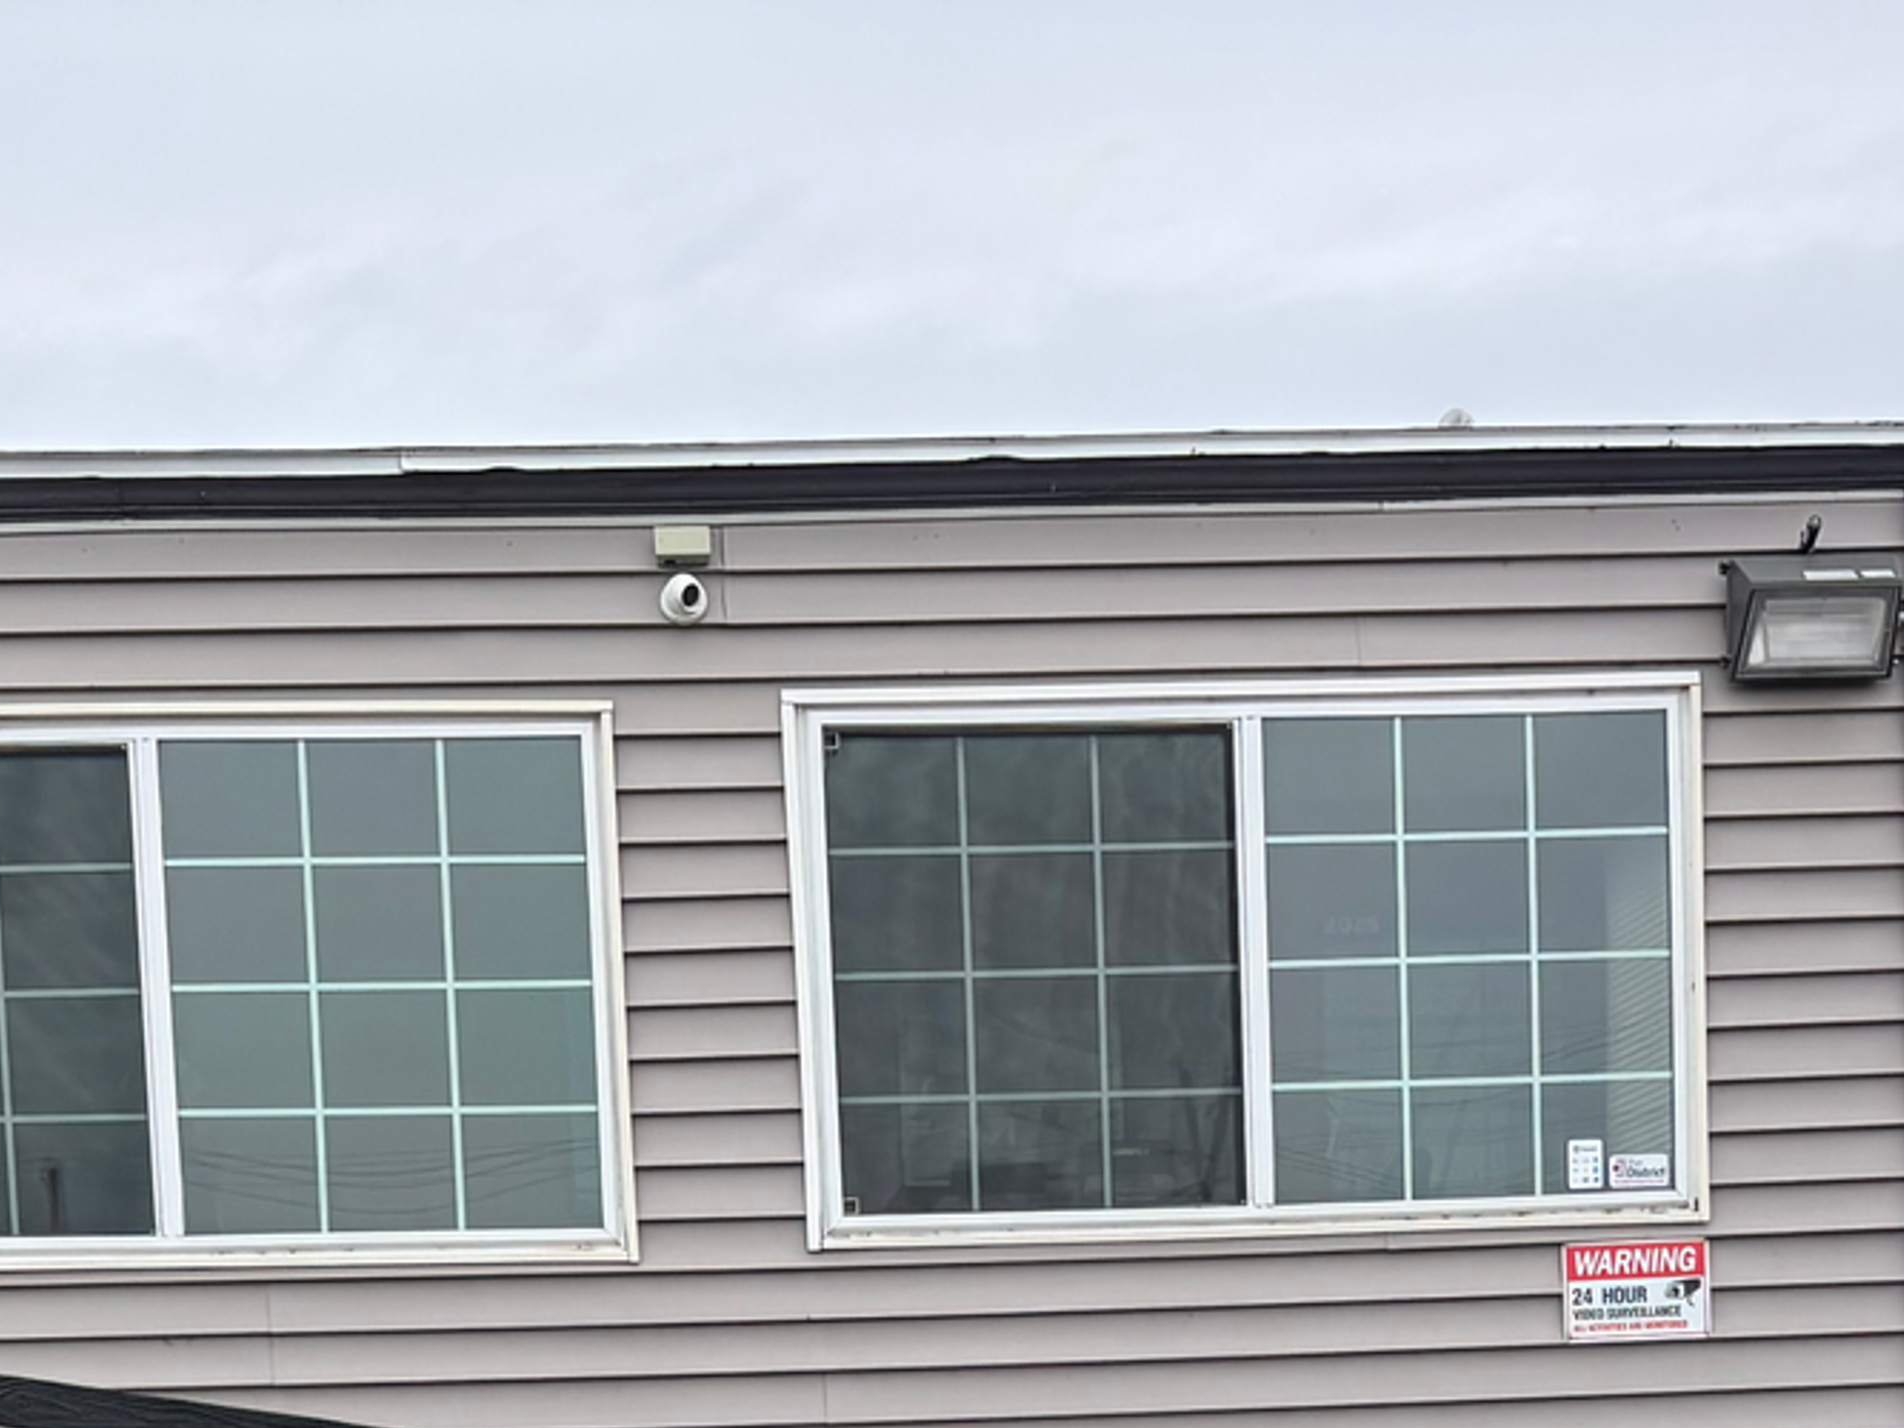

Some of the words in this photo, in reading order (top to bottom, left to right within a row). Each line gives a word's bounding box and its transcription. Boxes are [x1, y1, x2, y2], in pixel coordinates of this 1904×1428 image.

[1574, 1246, 1696, 1277] WARNING
[1572, 1287, 1593, 1305] 24
[1602, 1286, 1647, 1304] HOUR
[1573, 1307, 1604, 1320] VIDEO
[1607, 1305, 1682, 1319] SURVEILLANCE
